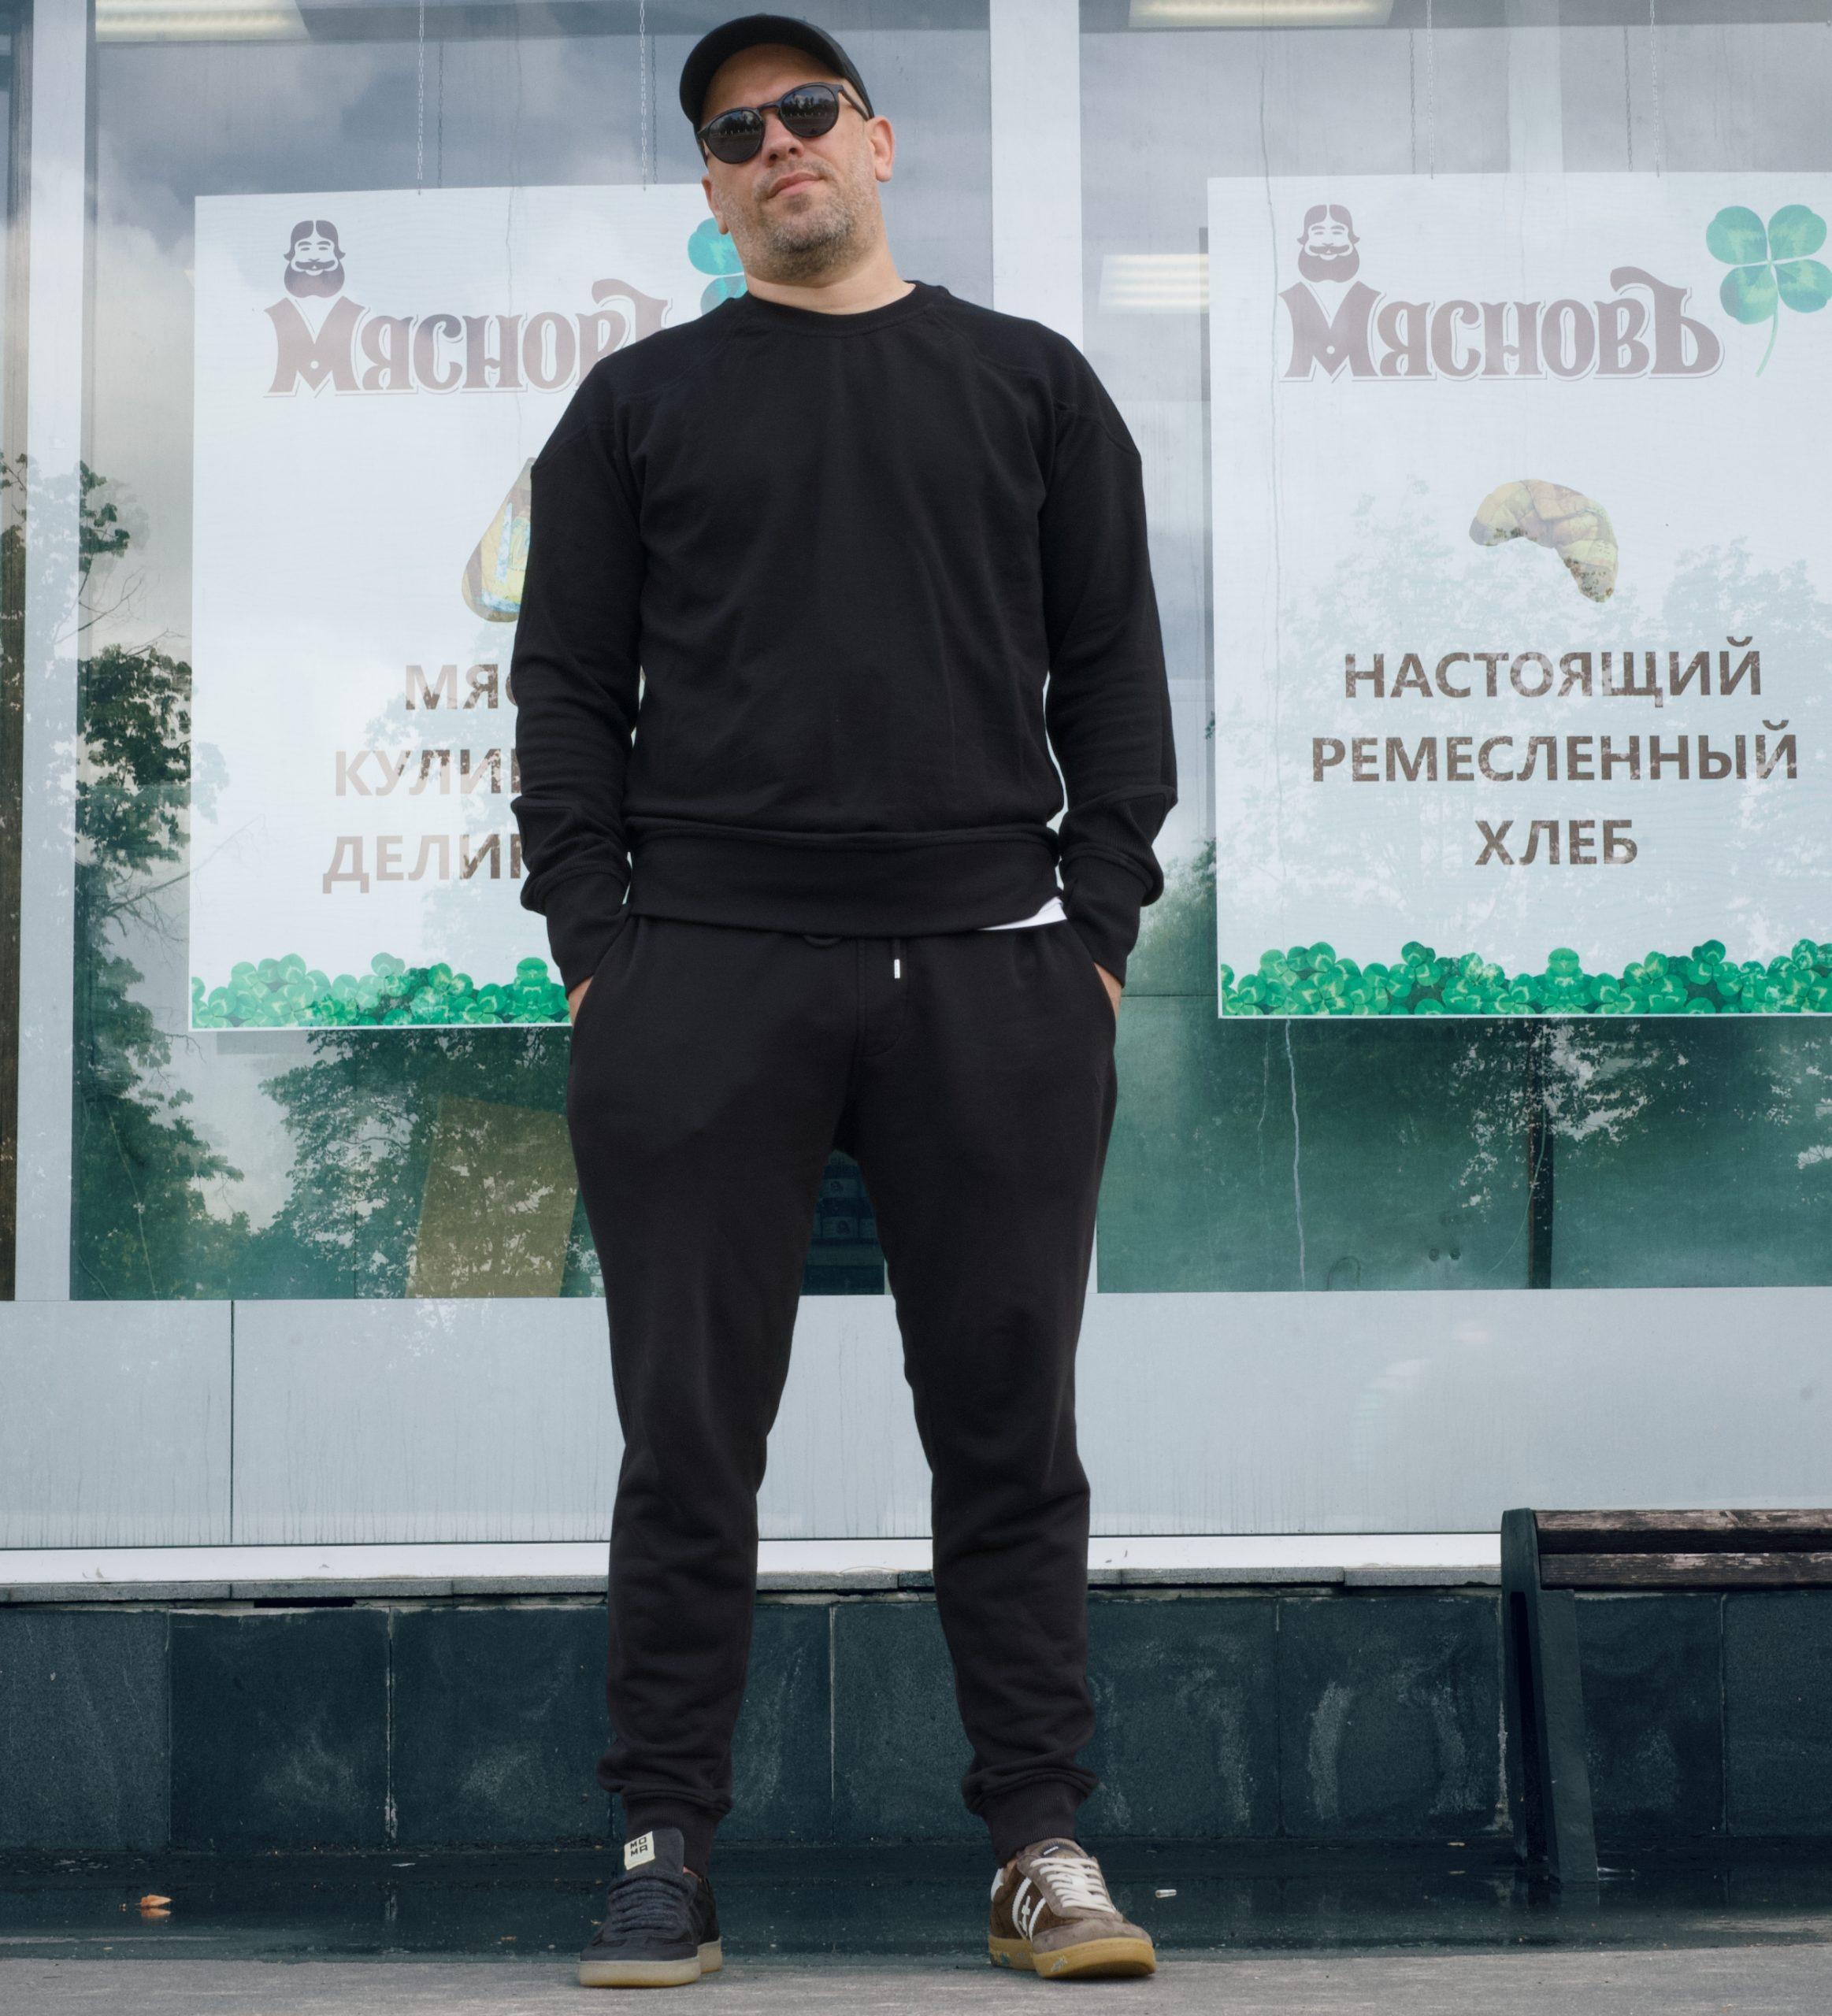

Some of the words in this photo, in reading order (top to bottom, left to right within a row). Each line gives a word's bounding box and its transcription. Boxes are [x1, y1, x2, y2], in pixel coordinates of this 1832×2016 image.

[405, 663, 517, 710] МЯ
[1344, 636, 1763, 708] НАСТОЯЩИЙ
[334, 748, 522, 797] КУЛИ
[1311, 719, 1799, 782] РЕМЕСЛЕННЫЙ
[321, 834, 522, 894] ДЕЛИ
[1474, 819, 1639, 866] ХЛЕБ
